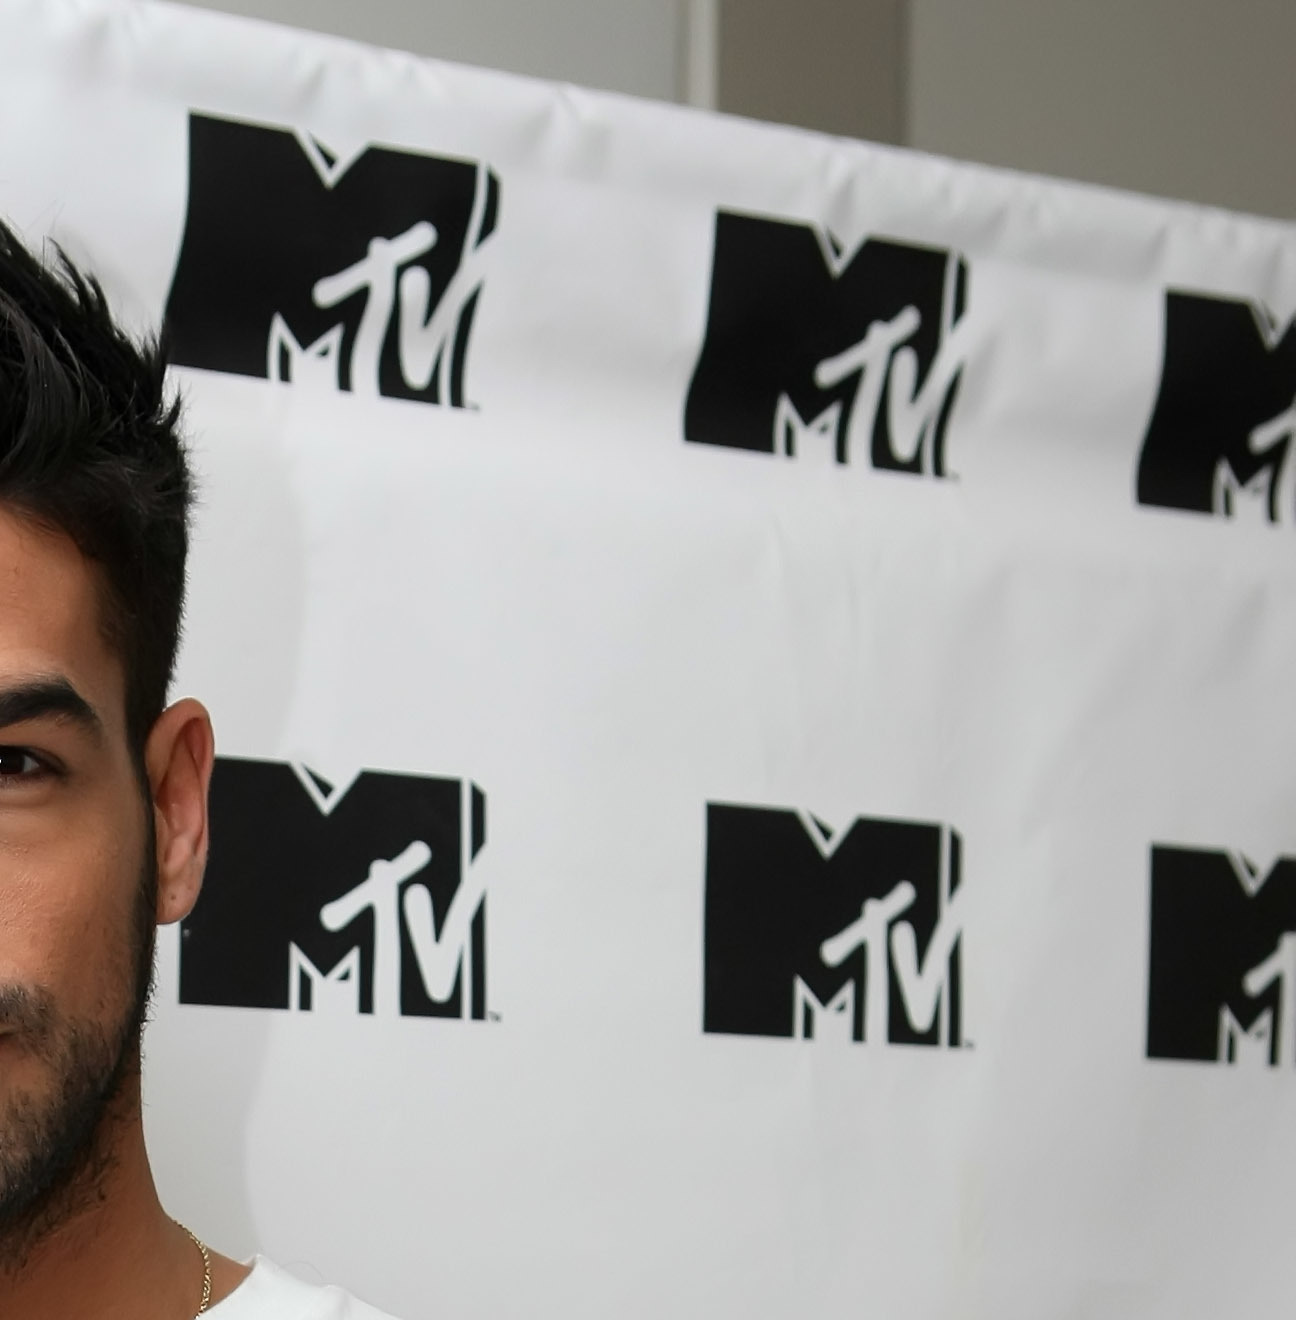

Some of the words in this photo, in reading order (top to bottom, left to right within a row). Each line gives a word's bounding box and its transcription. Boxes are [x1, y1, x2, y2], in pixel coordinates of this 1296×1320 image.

[166, 107, 501, 410] MTV
[683, 207, 970, 478] MTV
[179, 754, 488, 1021] MTV
[703, 800, 963, 1050] MTV
